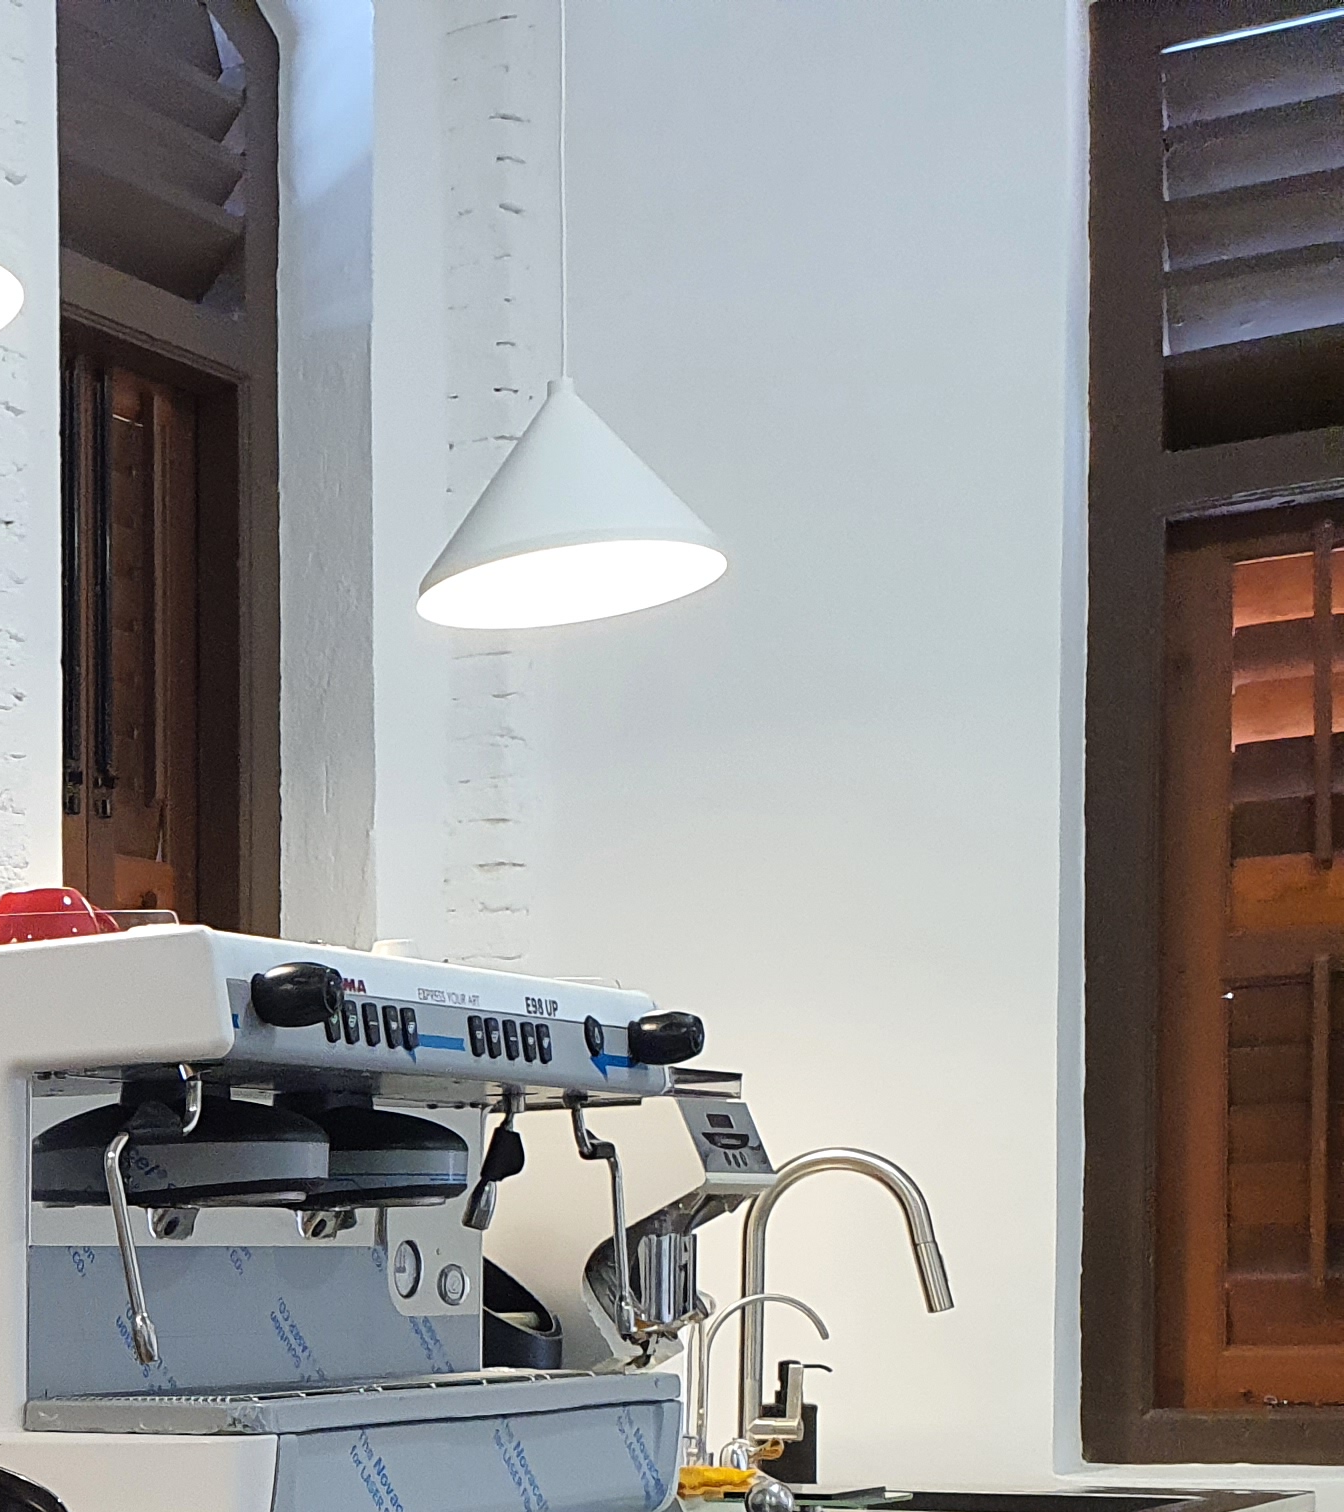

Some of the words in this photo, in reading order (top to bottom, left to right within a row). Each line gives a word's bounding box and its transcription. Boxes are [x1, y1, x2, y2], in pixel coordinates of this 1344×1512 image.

[418, 988, 445, 1003] EXPRESS
[447, 992, 466, 1004] YOUR
[468, 995, 480, 1006] ART
[525, 997, 544, 1014] E98
[545, 999, 558, 1017] UP
[361, 1468, 385, 1511] LASER
